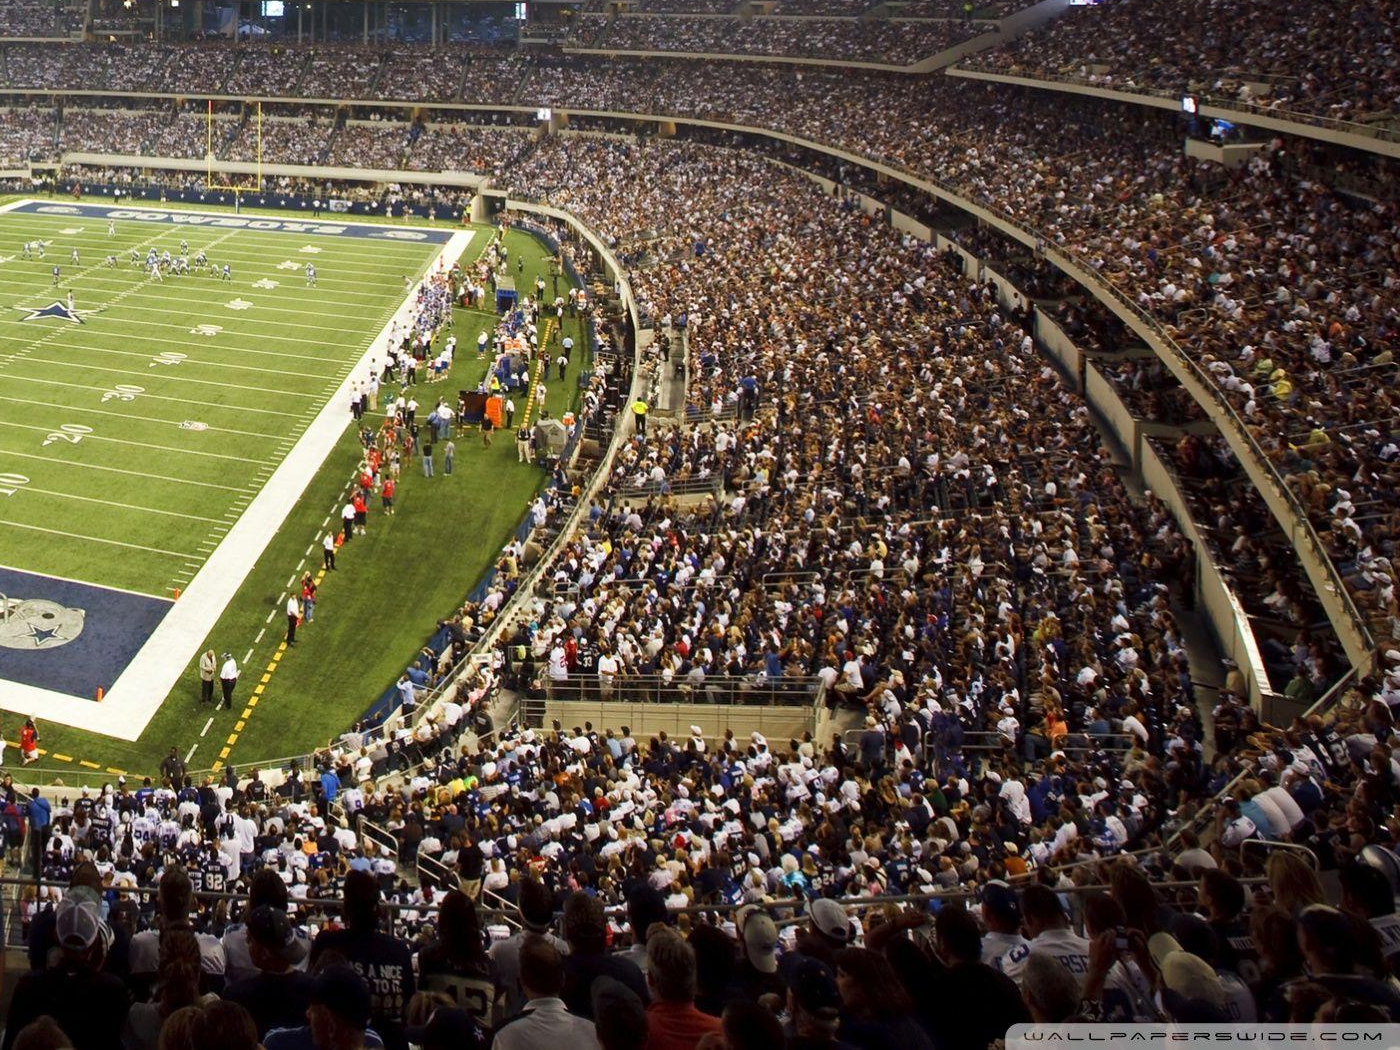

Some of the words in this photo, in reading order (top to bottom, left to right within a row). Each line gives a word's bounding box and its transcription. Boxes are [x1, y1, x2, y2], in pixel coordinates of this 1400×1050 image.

[106, 210, 348, 234] COWBOYS
[104, 385, 145, 401] 30
[47, 424, 93, 444] 20
[368, 964, 377, 978] A
[380, 965, 403, 980] NICE
[375, 978, 390, 994] TO
